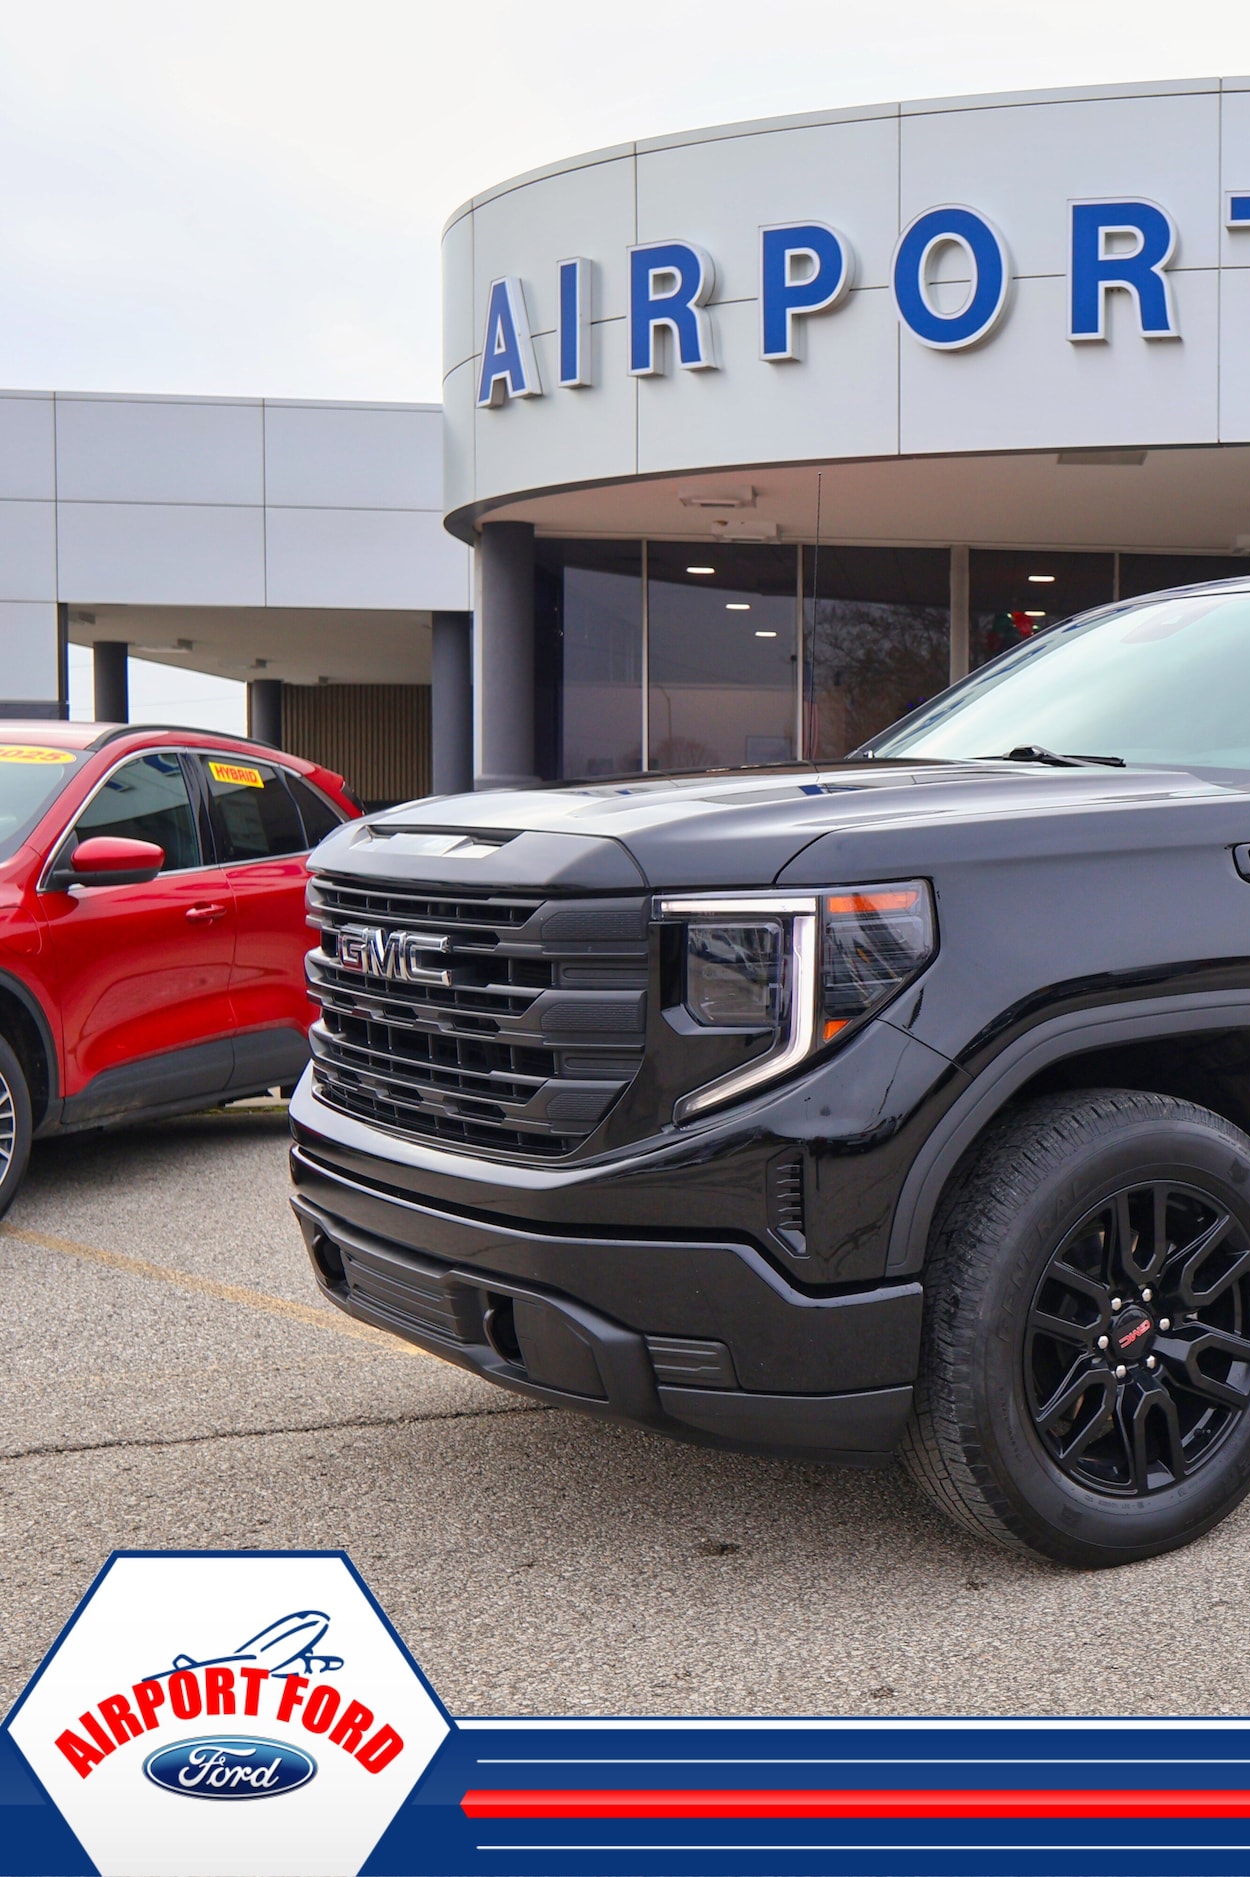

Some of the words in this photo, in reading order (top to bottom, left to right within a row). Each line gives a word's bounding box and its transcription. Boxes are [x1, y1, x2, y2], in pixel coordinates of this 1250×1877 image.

[0, 748, 66, 761] 025
[214, 765, 259, 785] HYBRID
[340, 923, 452, 987] GMC
